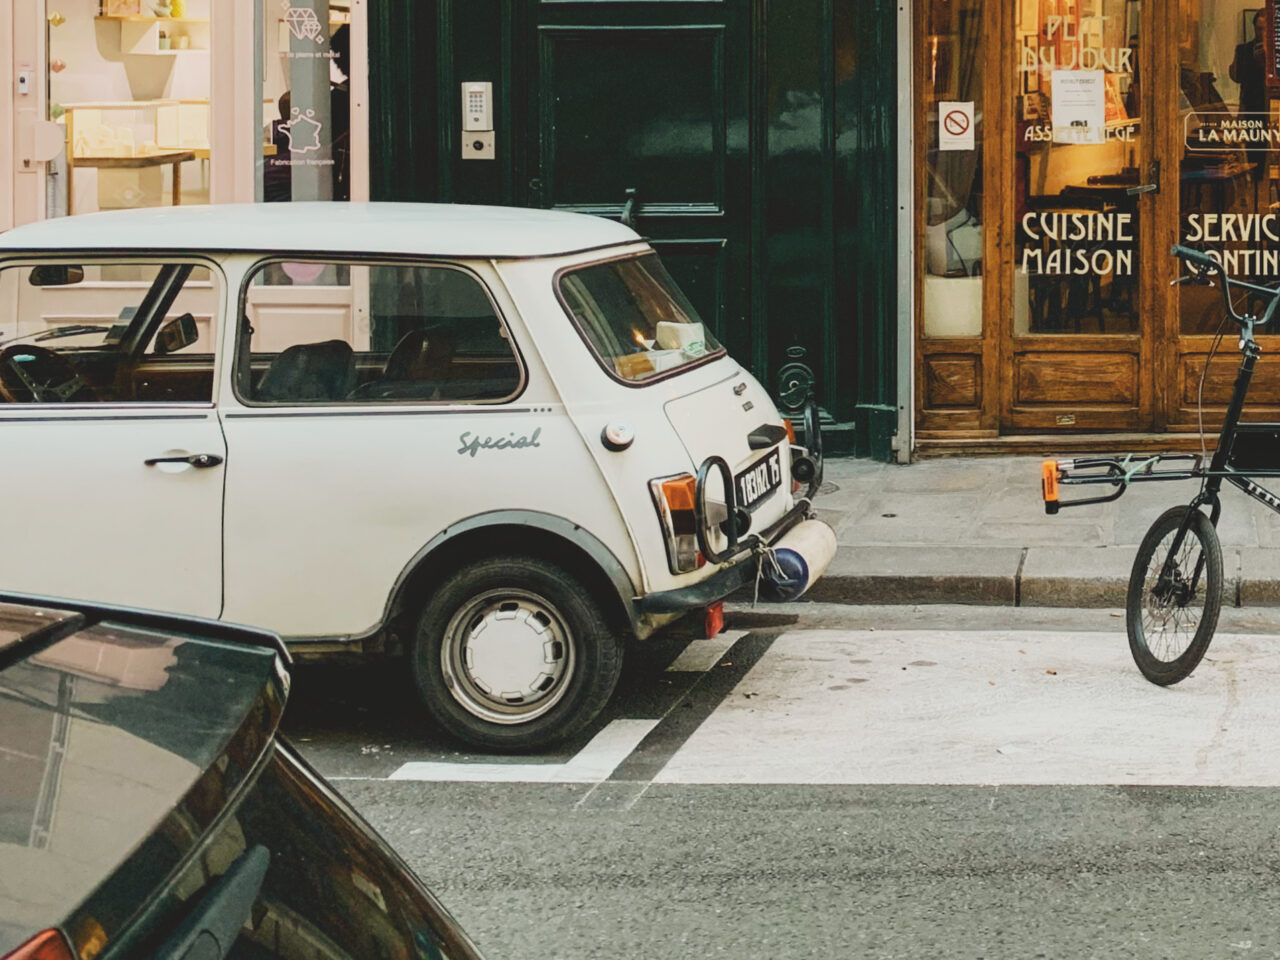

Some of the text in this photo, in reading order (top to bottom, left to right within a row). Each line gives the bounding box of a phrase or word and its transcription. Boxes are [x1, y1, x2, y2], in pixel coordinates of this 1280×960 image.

[1021, 46, 1133, 73] DU JOUR
[1198, 129, 1220, 142] LA
[1220, 120, 1263, 129] MAISON
[1022, 212, 1133, 241] CUISINE
[1021, 249, 1132, 275] MAISON
[457, 426, 542, 458] Special
